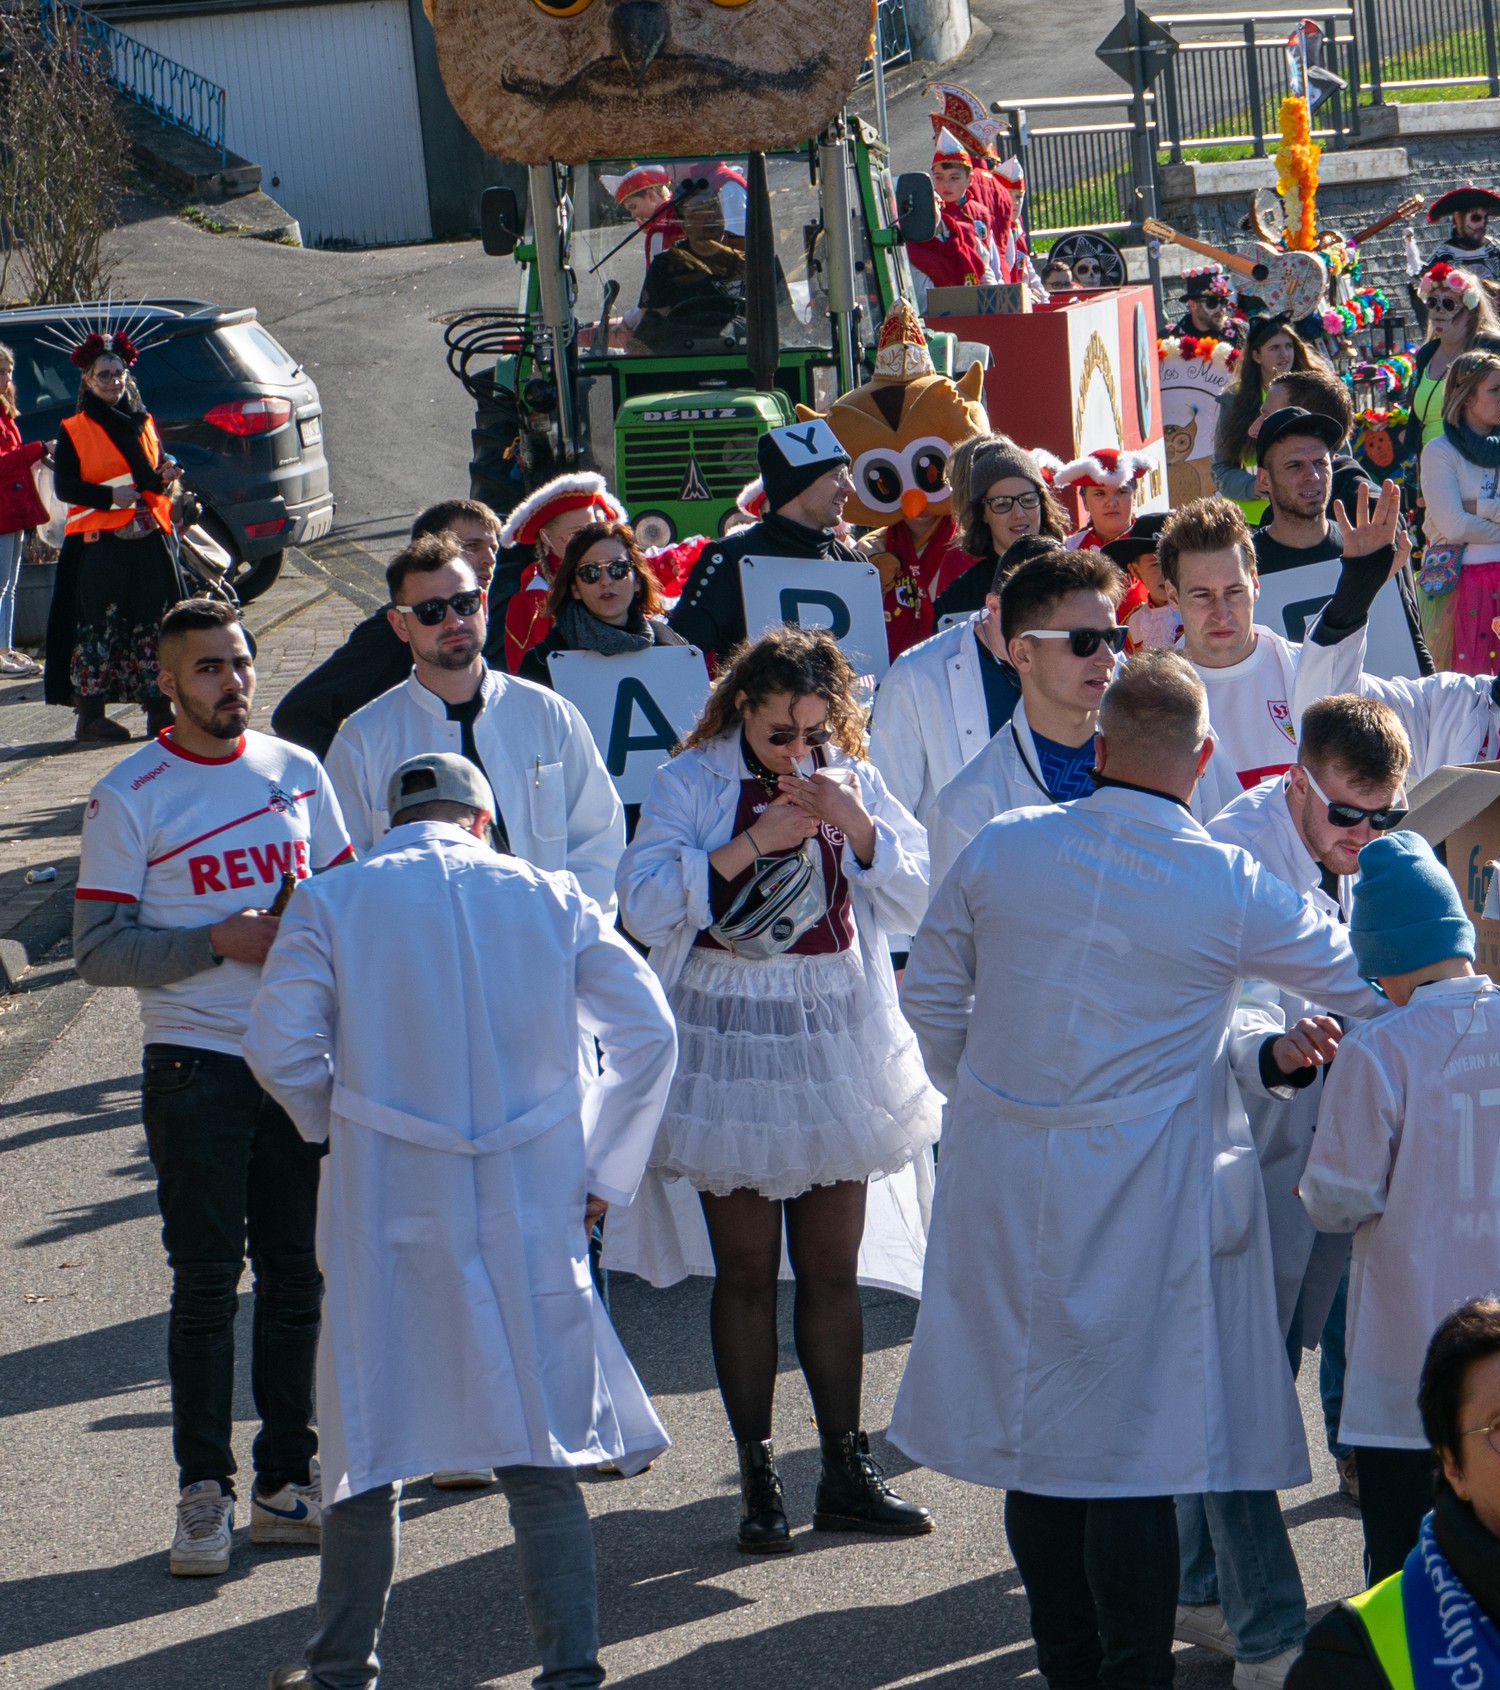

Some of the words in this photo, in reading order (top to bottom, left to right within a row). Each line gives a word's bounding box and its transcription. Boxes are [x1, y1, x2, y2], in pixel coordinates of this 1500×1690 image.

[643, 408, 736, 421] DEUTZ
[785, 426, 818, 454] Y
[606, 676, 681, 776] A
[131, 761, 170, 790] uhlsport
[188, 840, 308, 895] REWE
